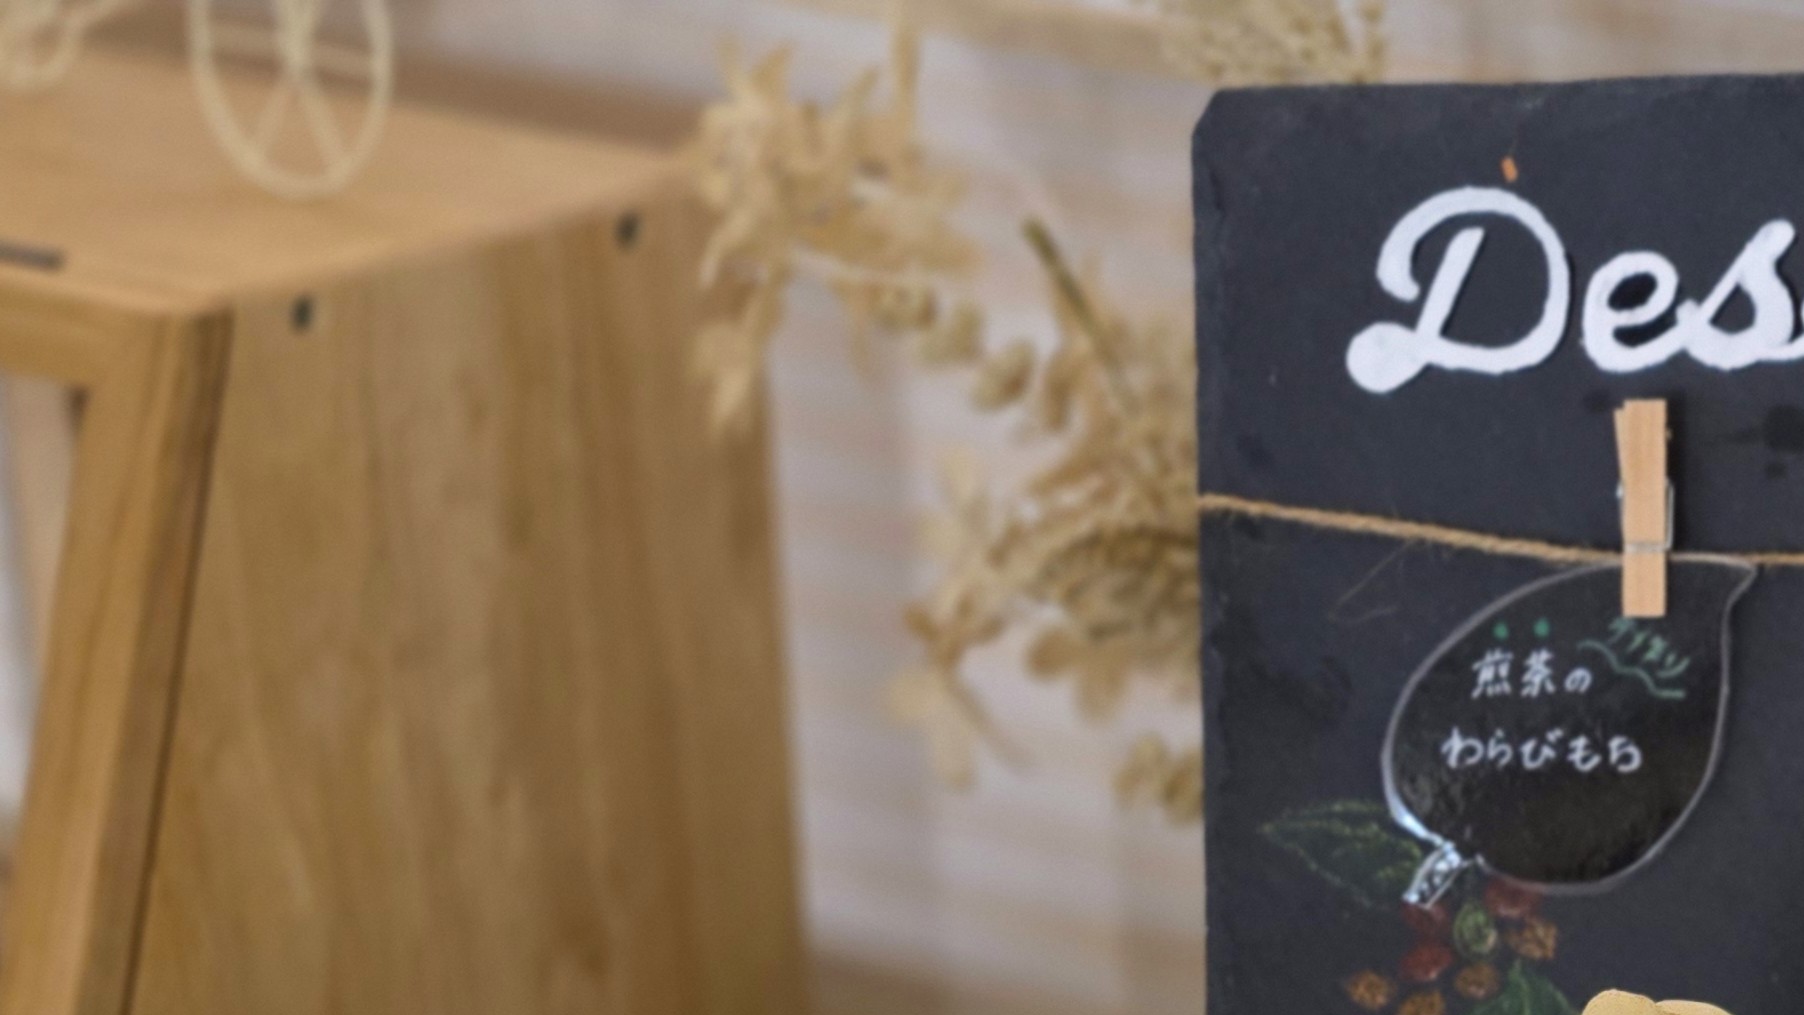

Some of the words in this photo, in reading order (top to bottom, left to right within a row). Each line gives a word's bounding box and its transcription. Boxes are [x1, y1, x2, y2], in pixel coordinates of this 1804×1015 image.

[1471, 647, 1593, 698] 煎茶の
[1440, 727, 1643, 774] わらびもち
